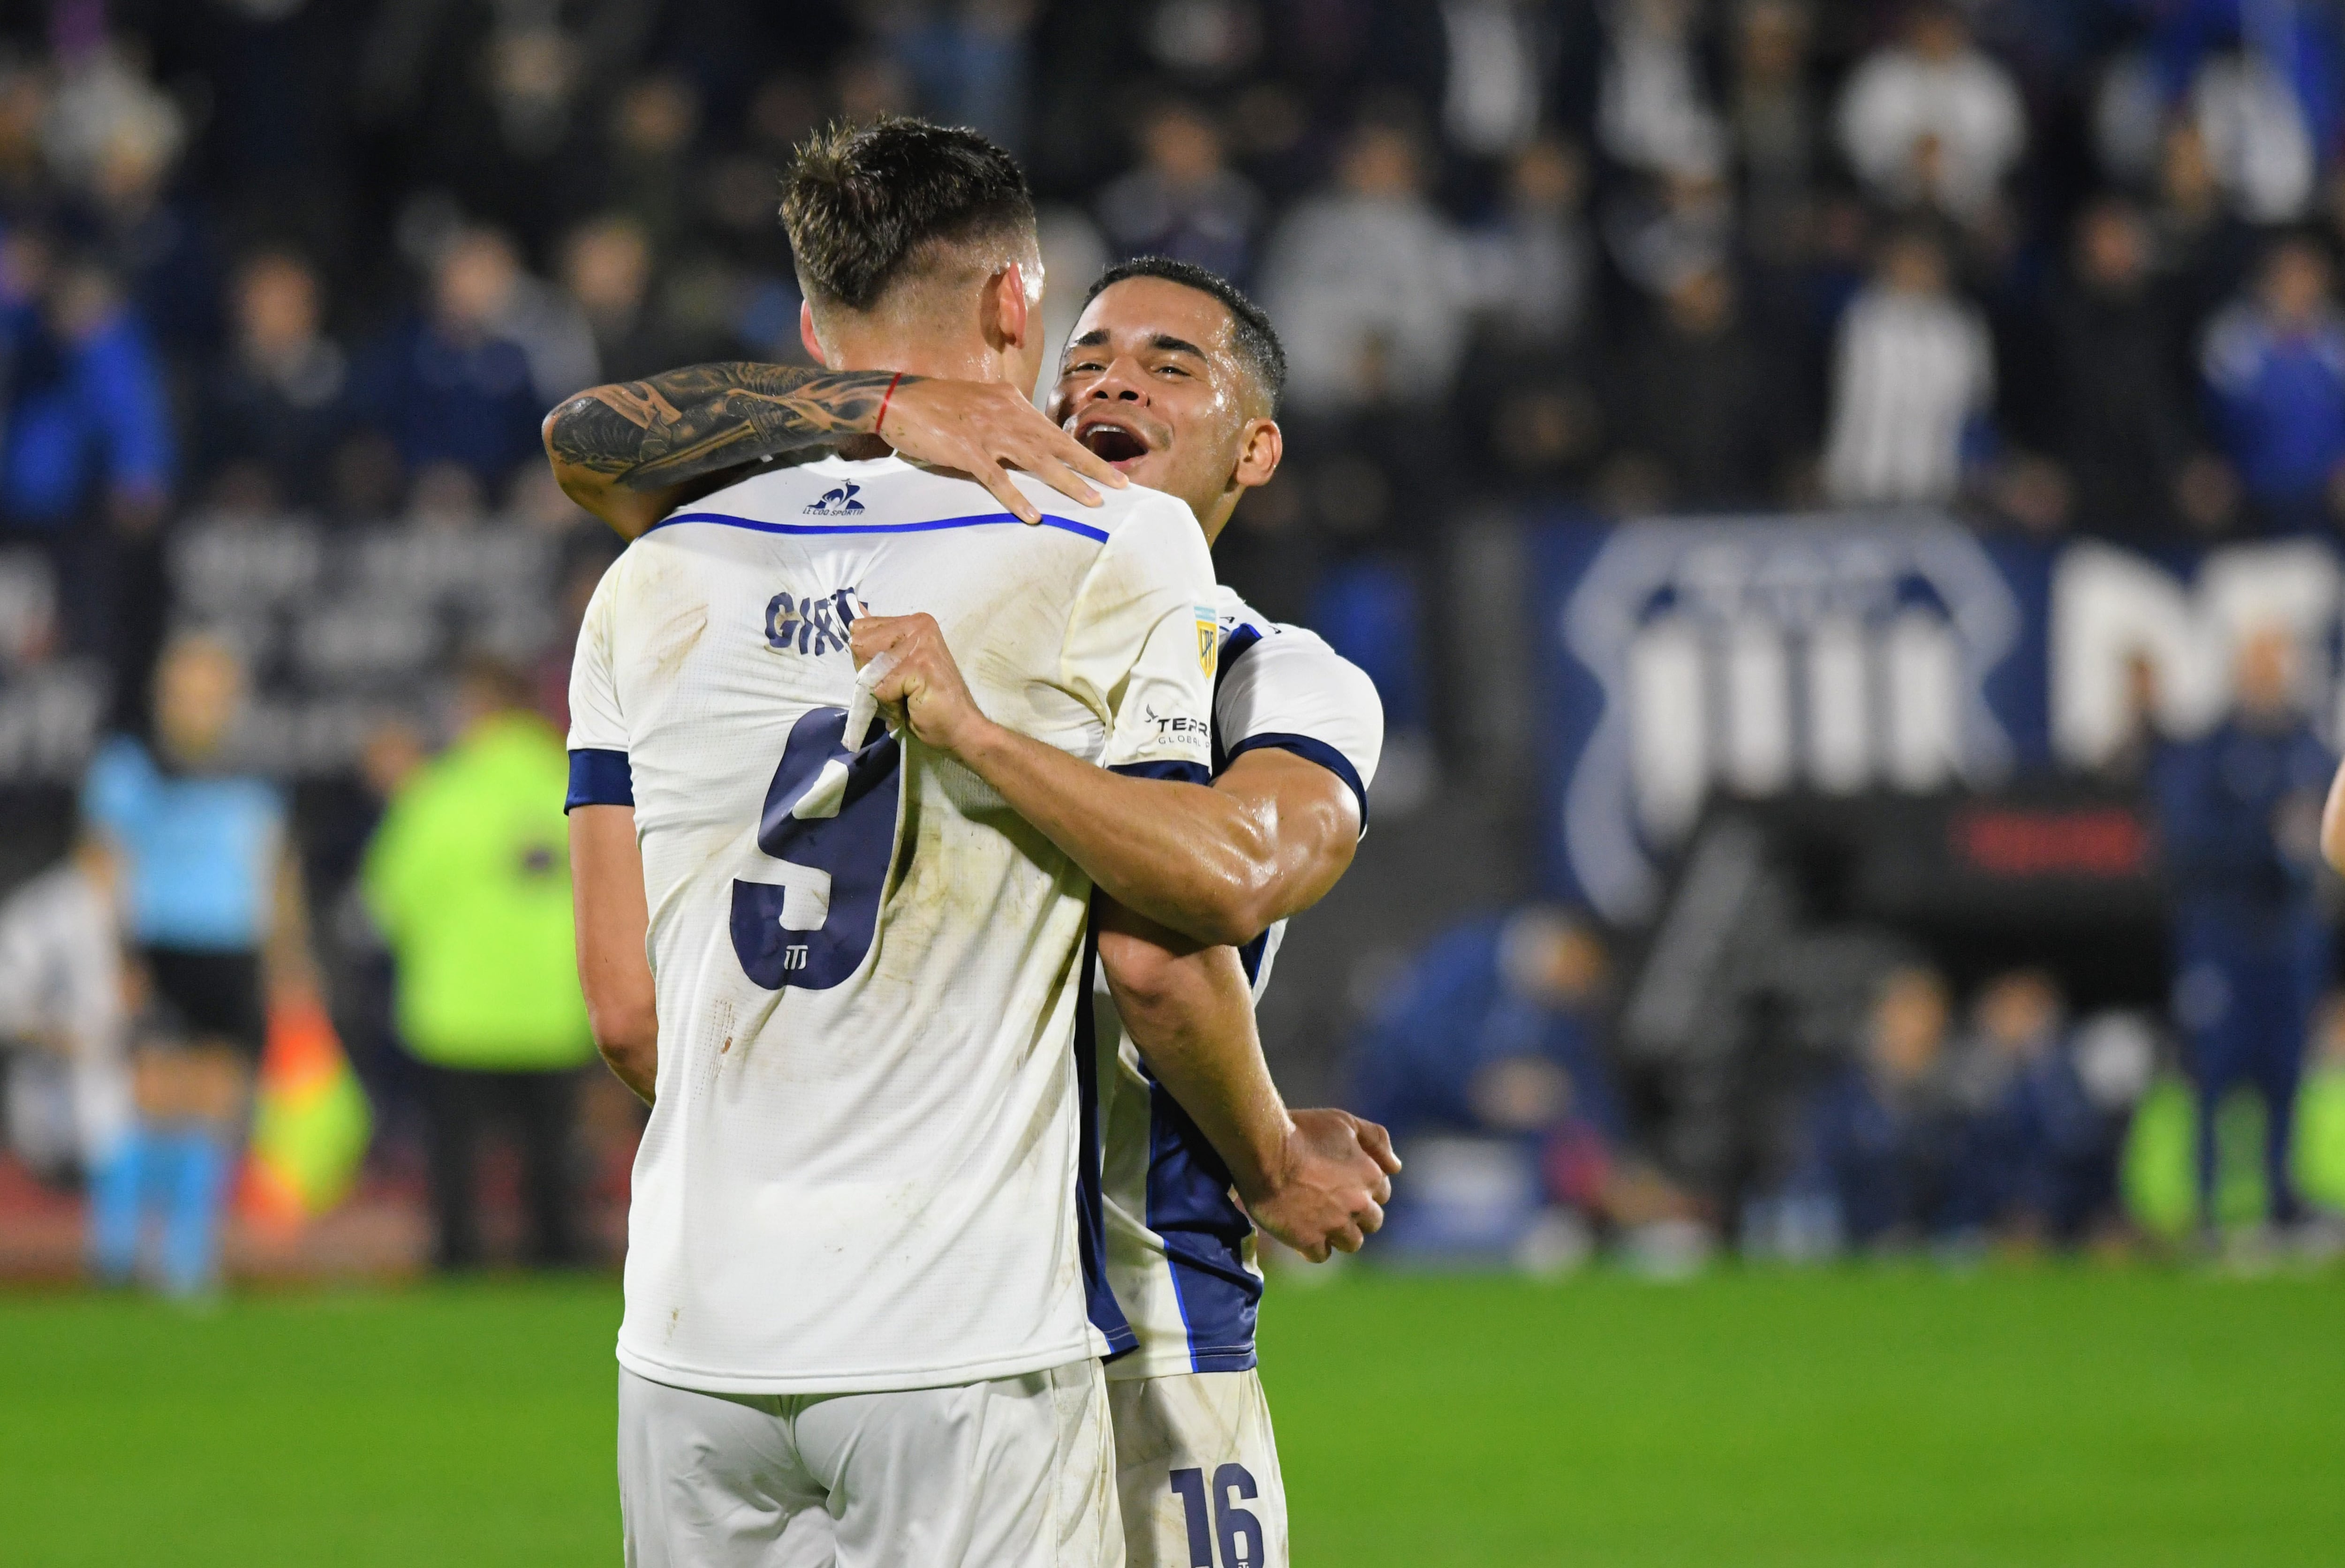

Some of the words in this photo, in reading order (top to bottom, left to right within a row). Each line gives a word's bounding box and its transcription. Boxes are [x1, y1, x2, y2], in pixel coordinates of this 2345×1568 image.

[1158, 735, 1201, 747] GLOBAL
[730, 707, 902, 990] 9
[1169, 1462, 1264, 1568] 16
